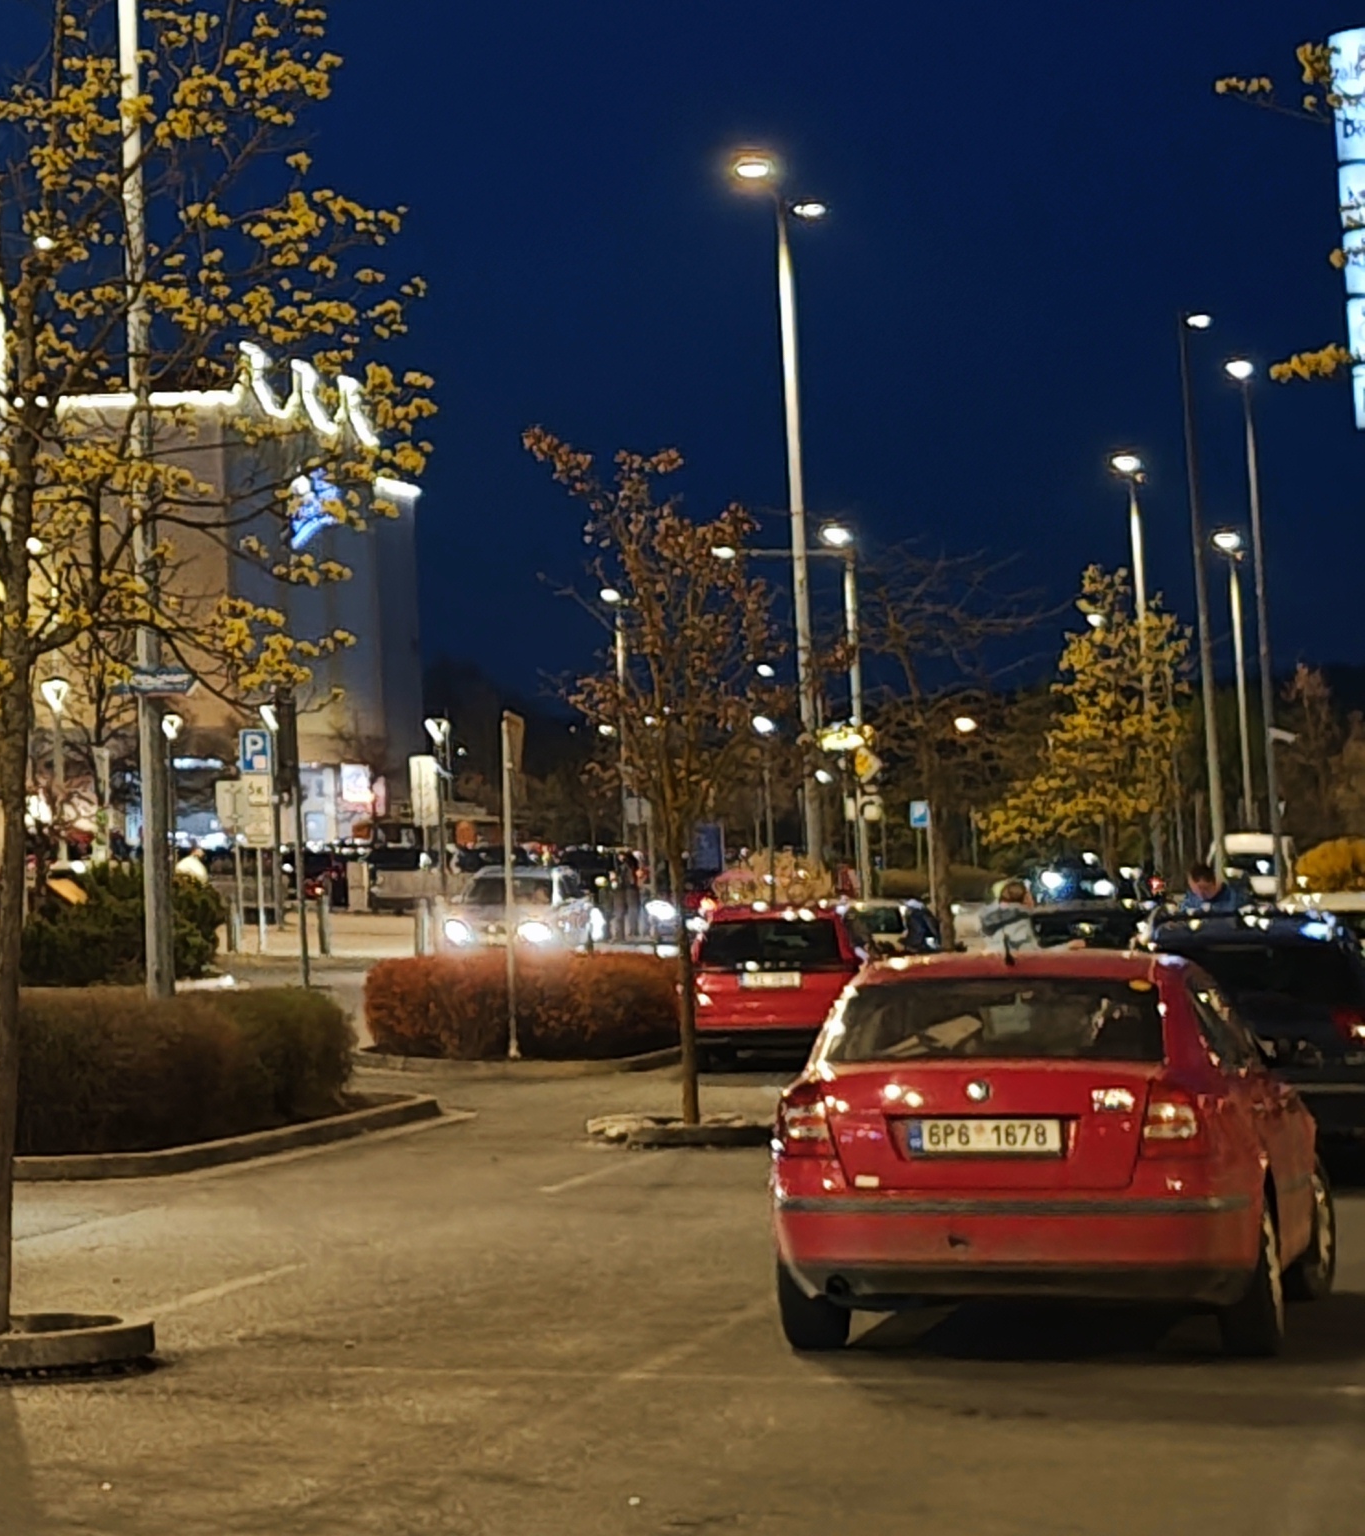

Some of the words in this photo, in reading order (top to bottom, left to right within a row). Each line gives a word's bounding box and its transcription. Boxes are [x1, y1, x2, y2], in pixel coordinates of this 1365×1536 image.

[244, 734, 265, 762] P
[927, 1122, 971, 1147] 6P6
[990, 1122, 1047, 1147] 1678
